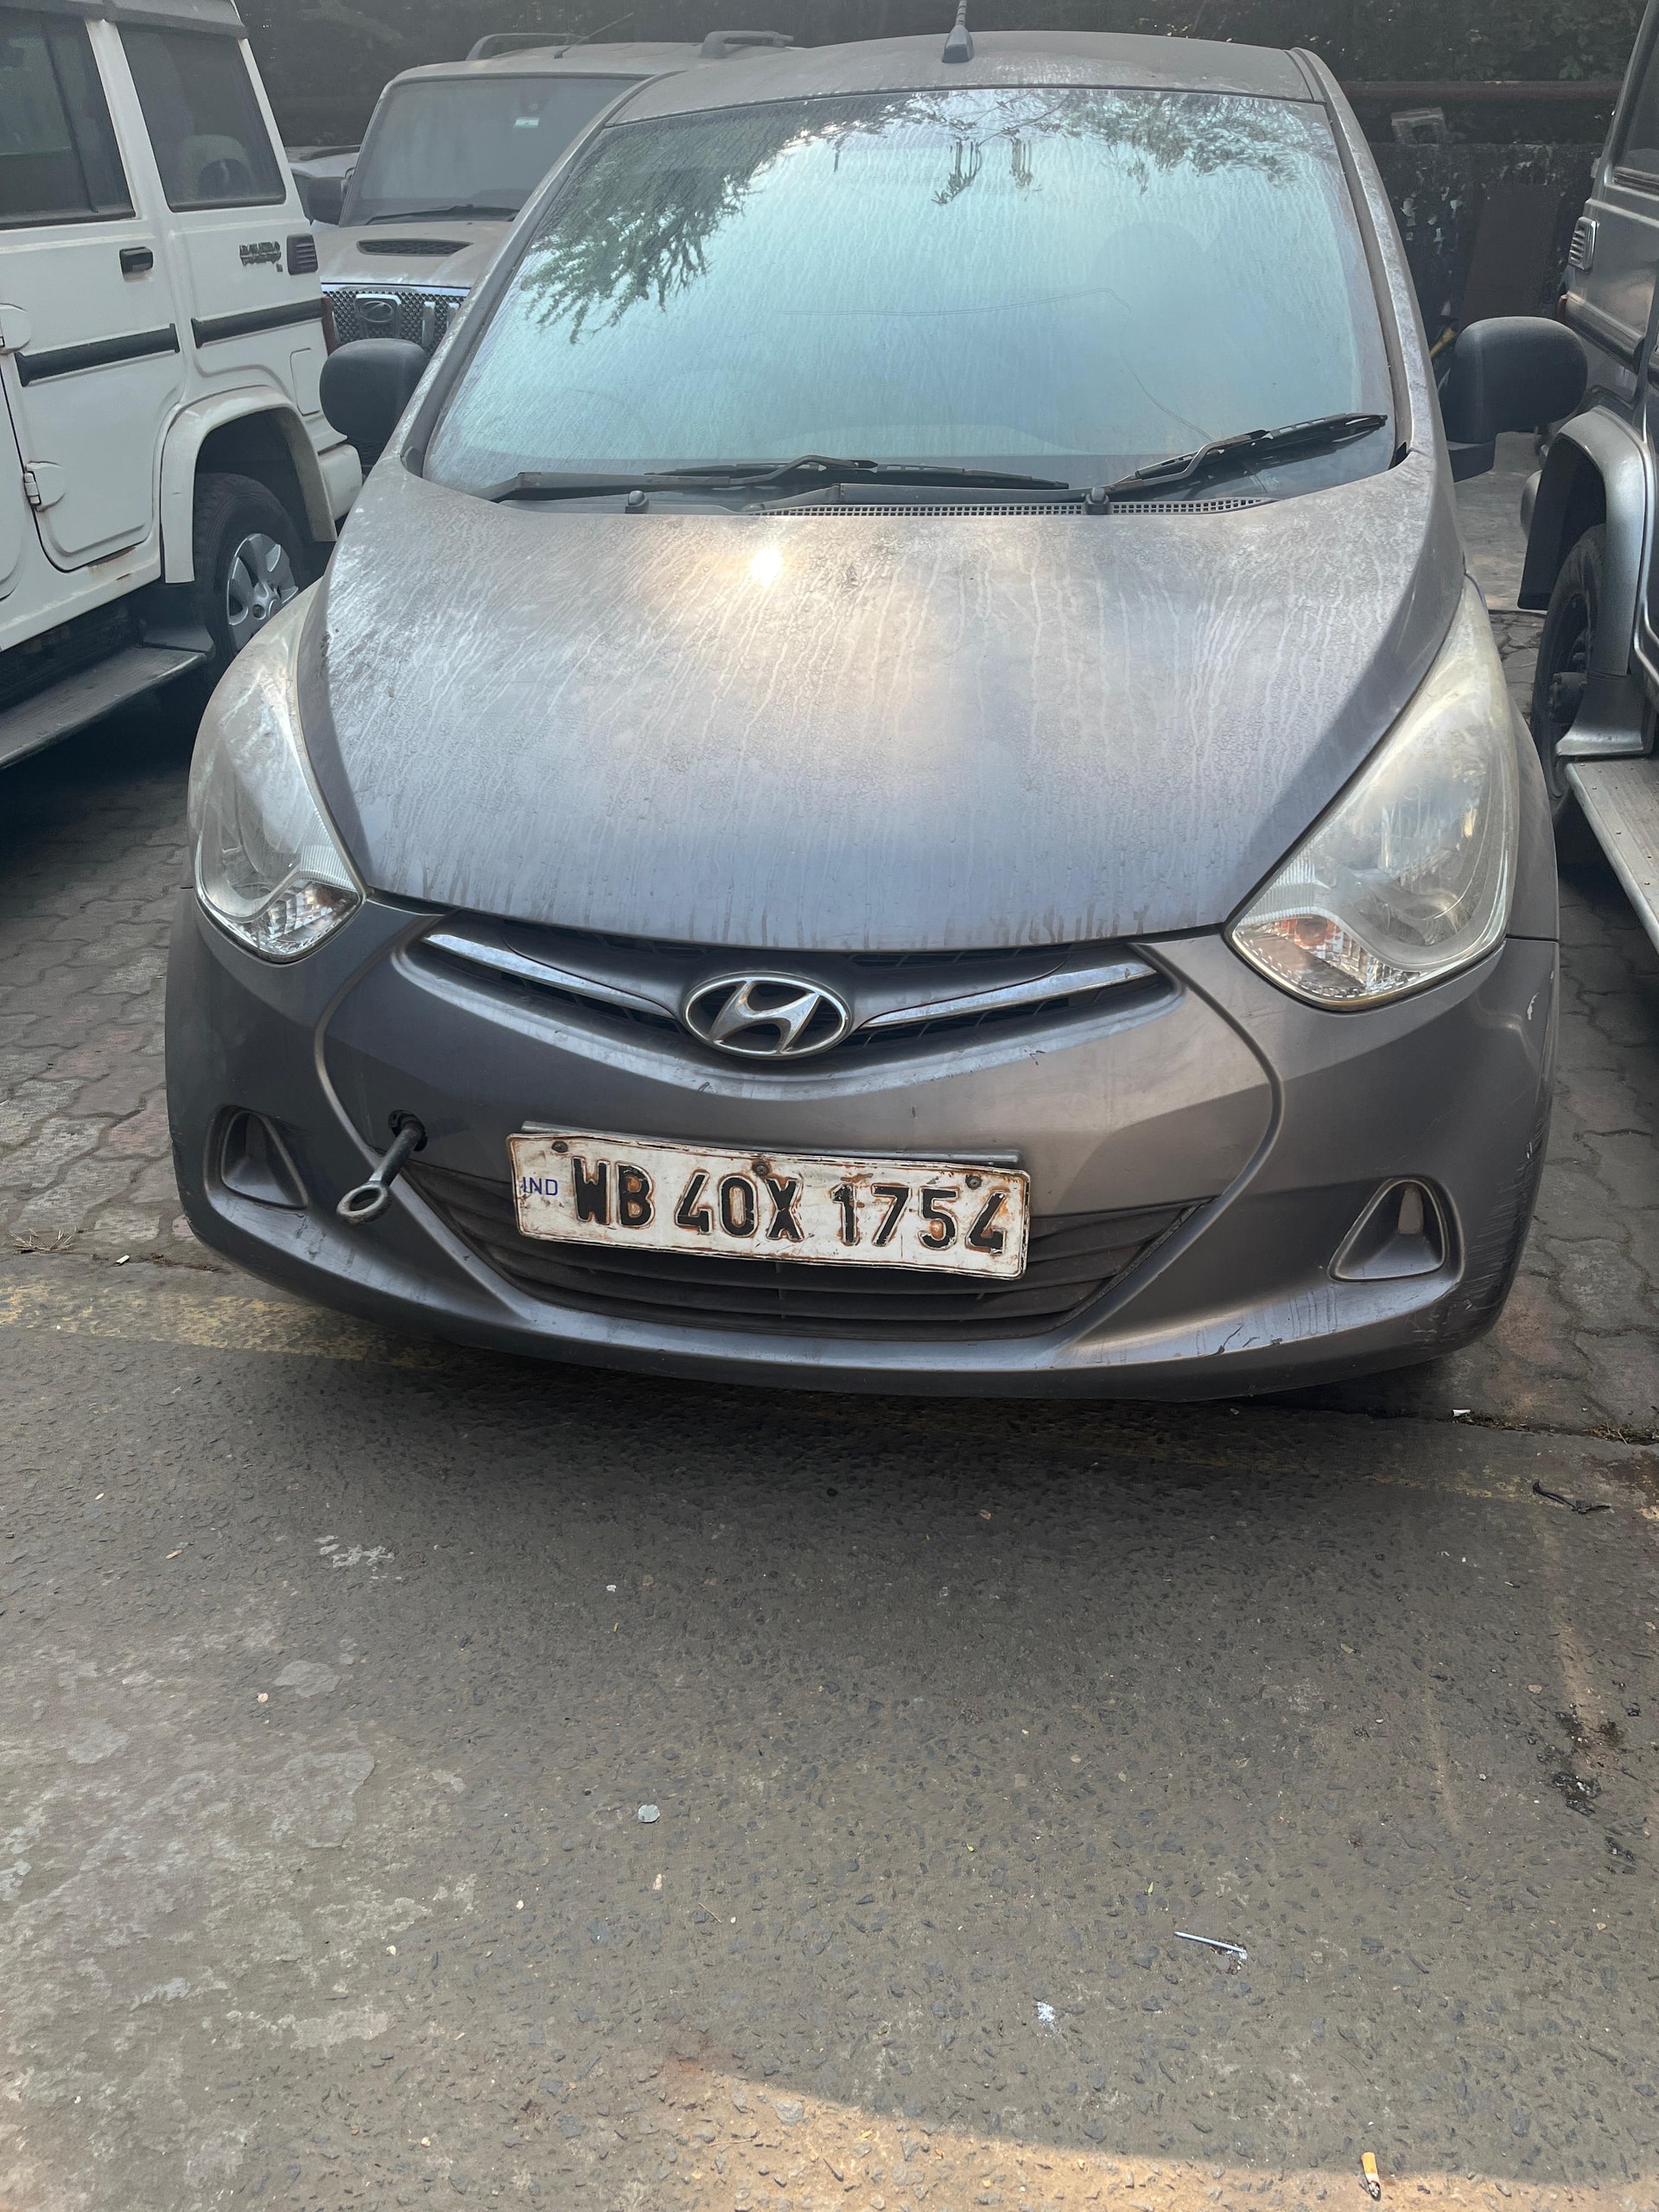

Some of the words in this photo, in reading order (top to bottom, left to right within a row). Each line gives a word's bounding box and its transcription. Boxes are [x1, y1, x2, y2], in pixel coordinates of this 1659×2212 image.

[523, 1177, 558, 1196] IND
[572, 1156, 655, 1227] WB
[675, 1170, 804, 1242] 40X
[831, 1182, 1007, 1255] 1754
